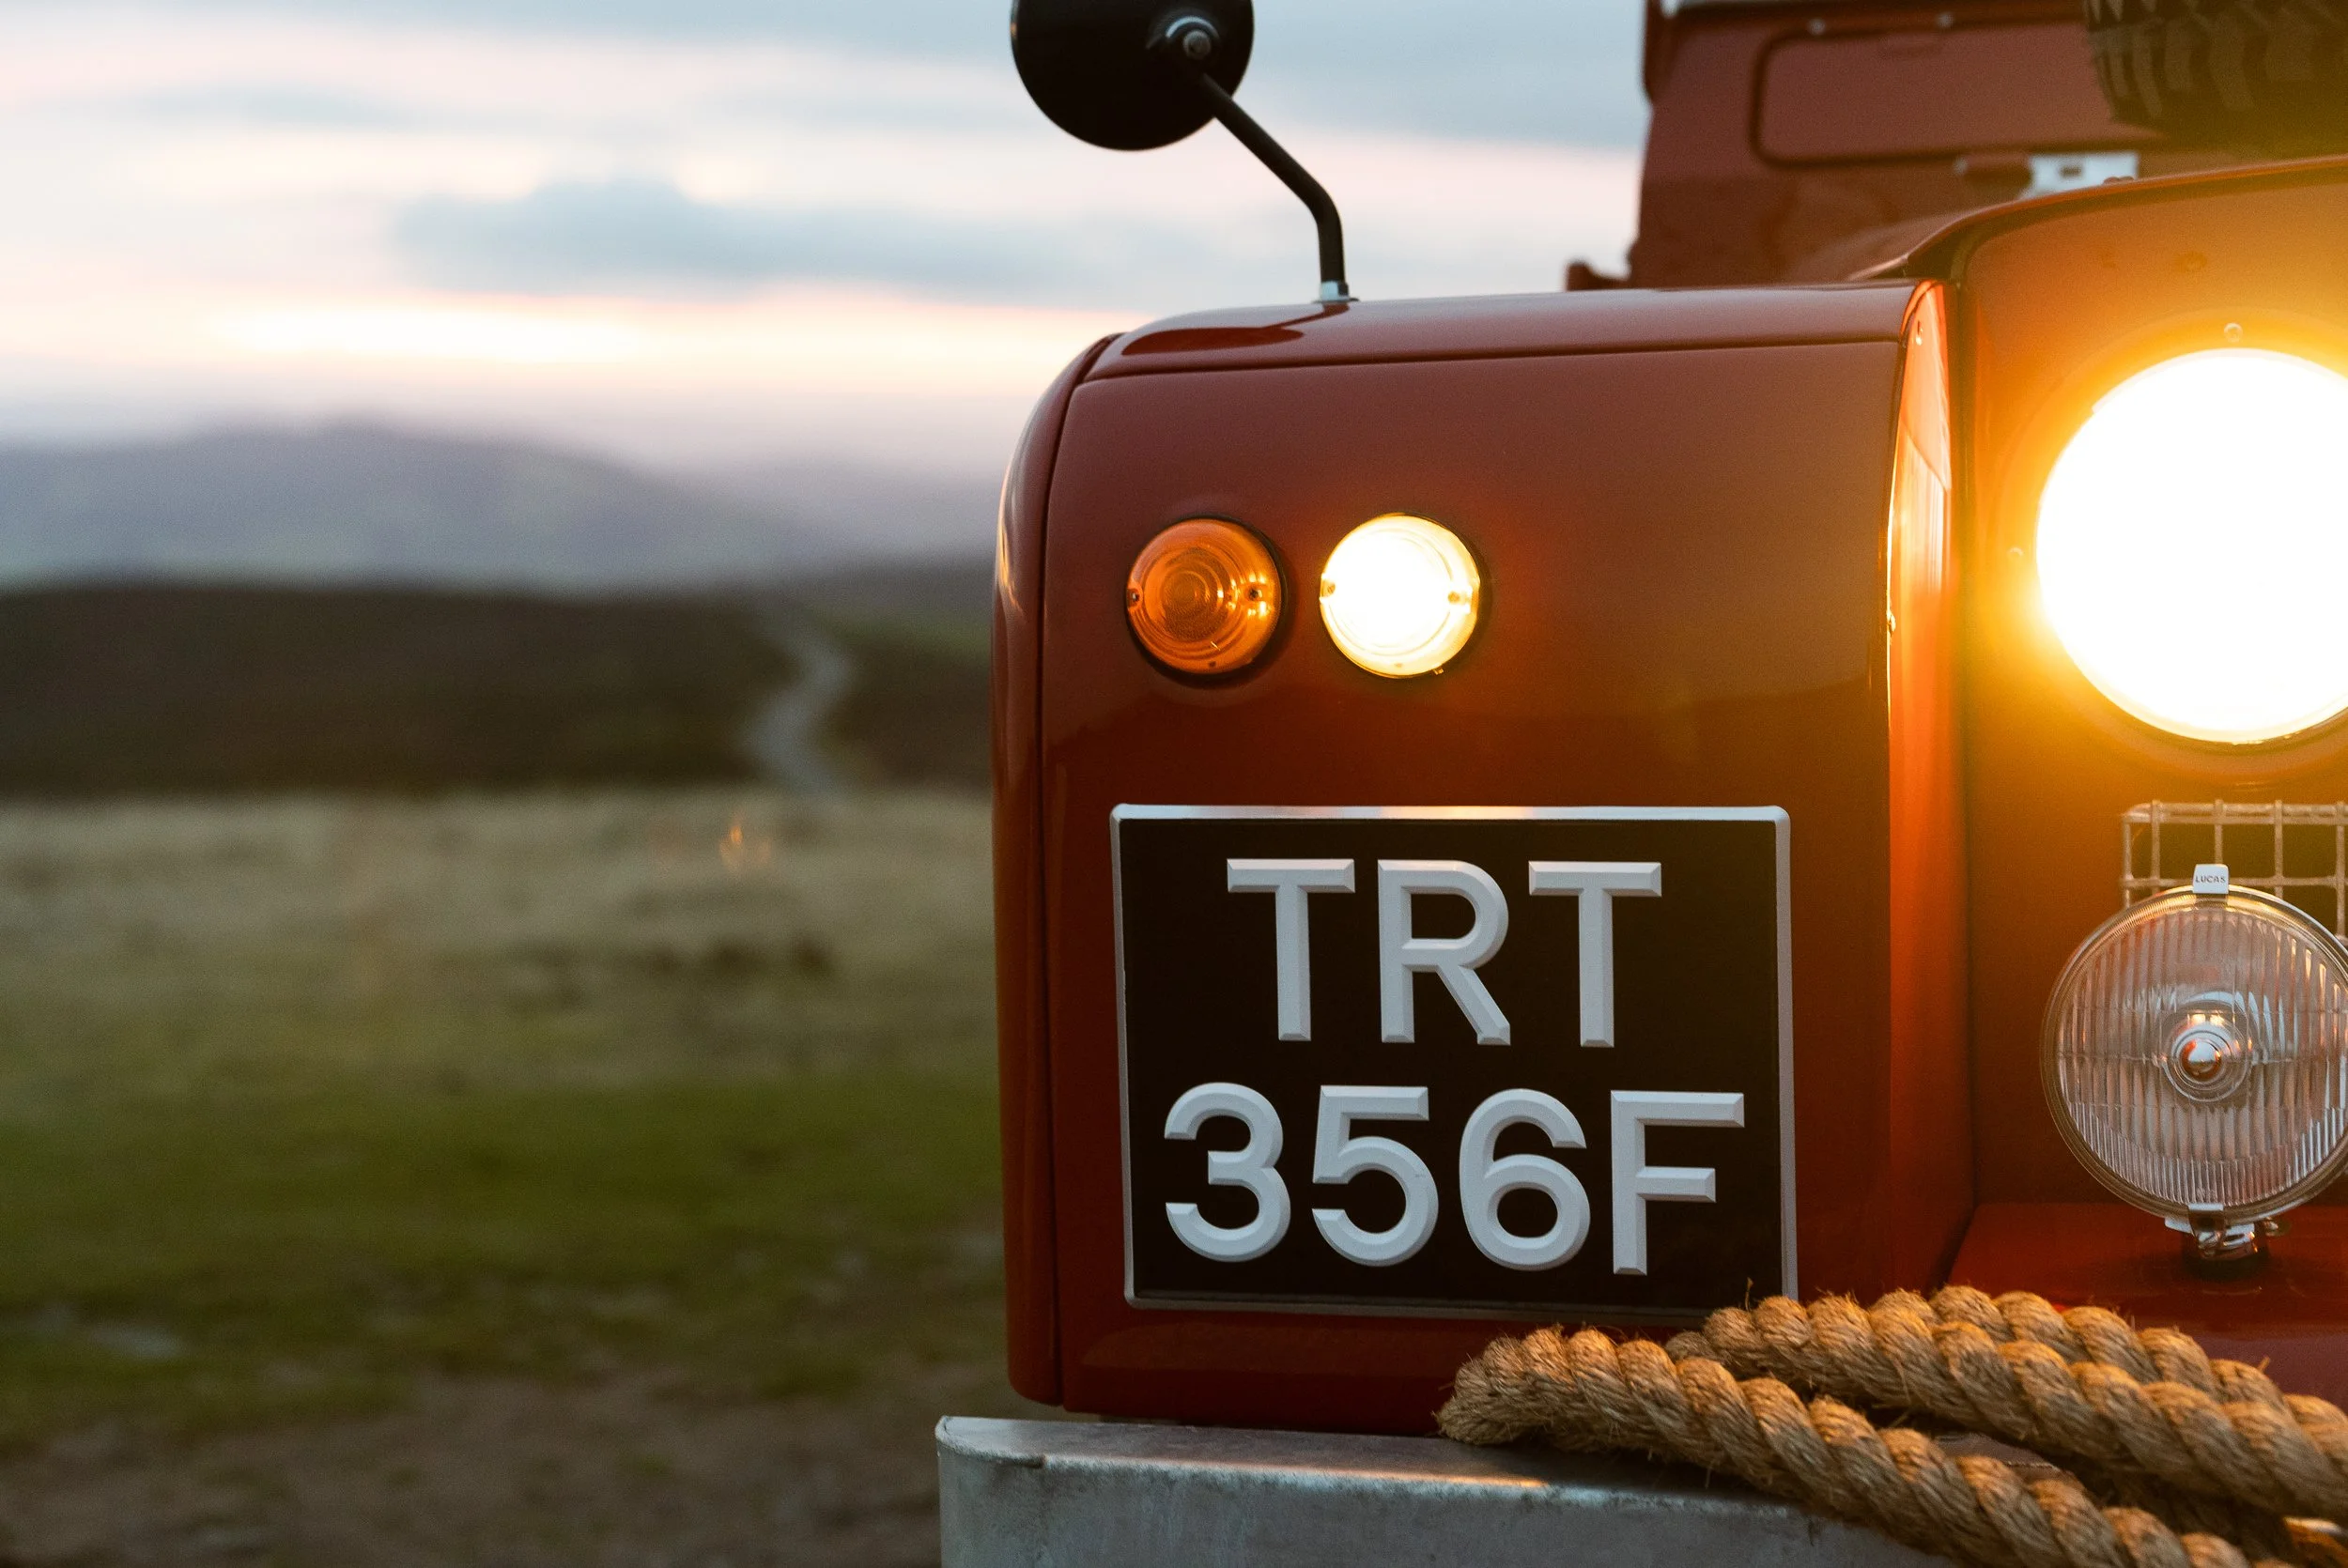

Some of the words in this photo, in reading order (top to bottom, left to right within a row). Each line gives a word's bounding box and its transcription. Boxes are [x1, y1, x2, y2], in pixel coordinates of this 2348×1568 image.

[1227, 858, 1662, 1048] TRT
[2195, 874, 2226, 884] LUCAS
[1164, 1082, 1745, 1276] 356F
